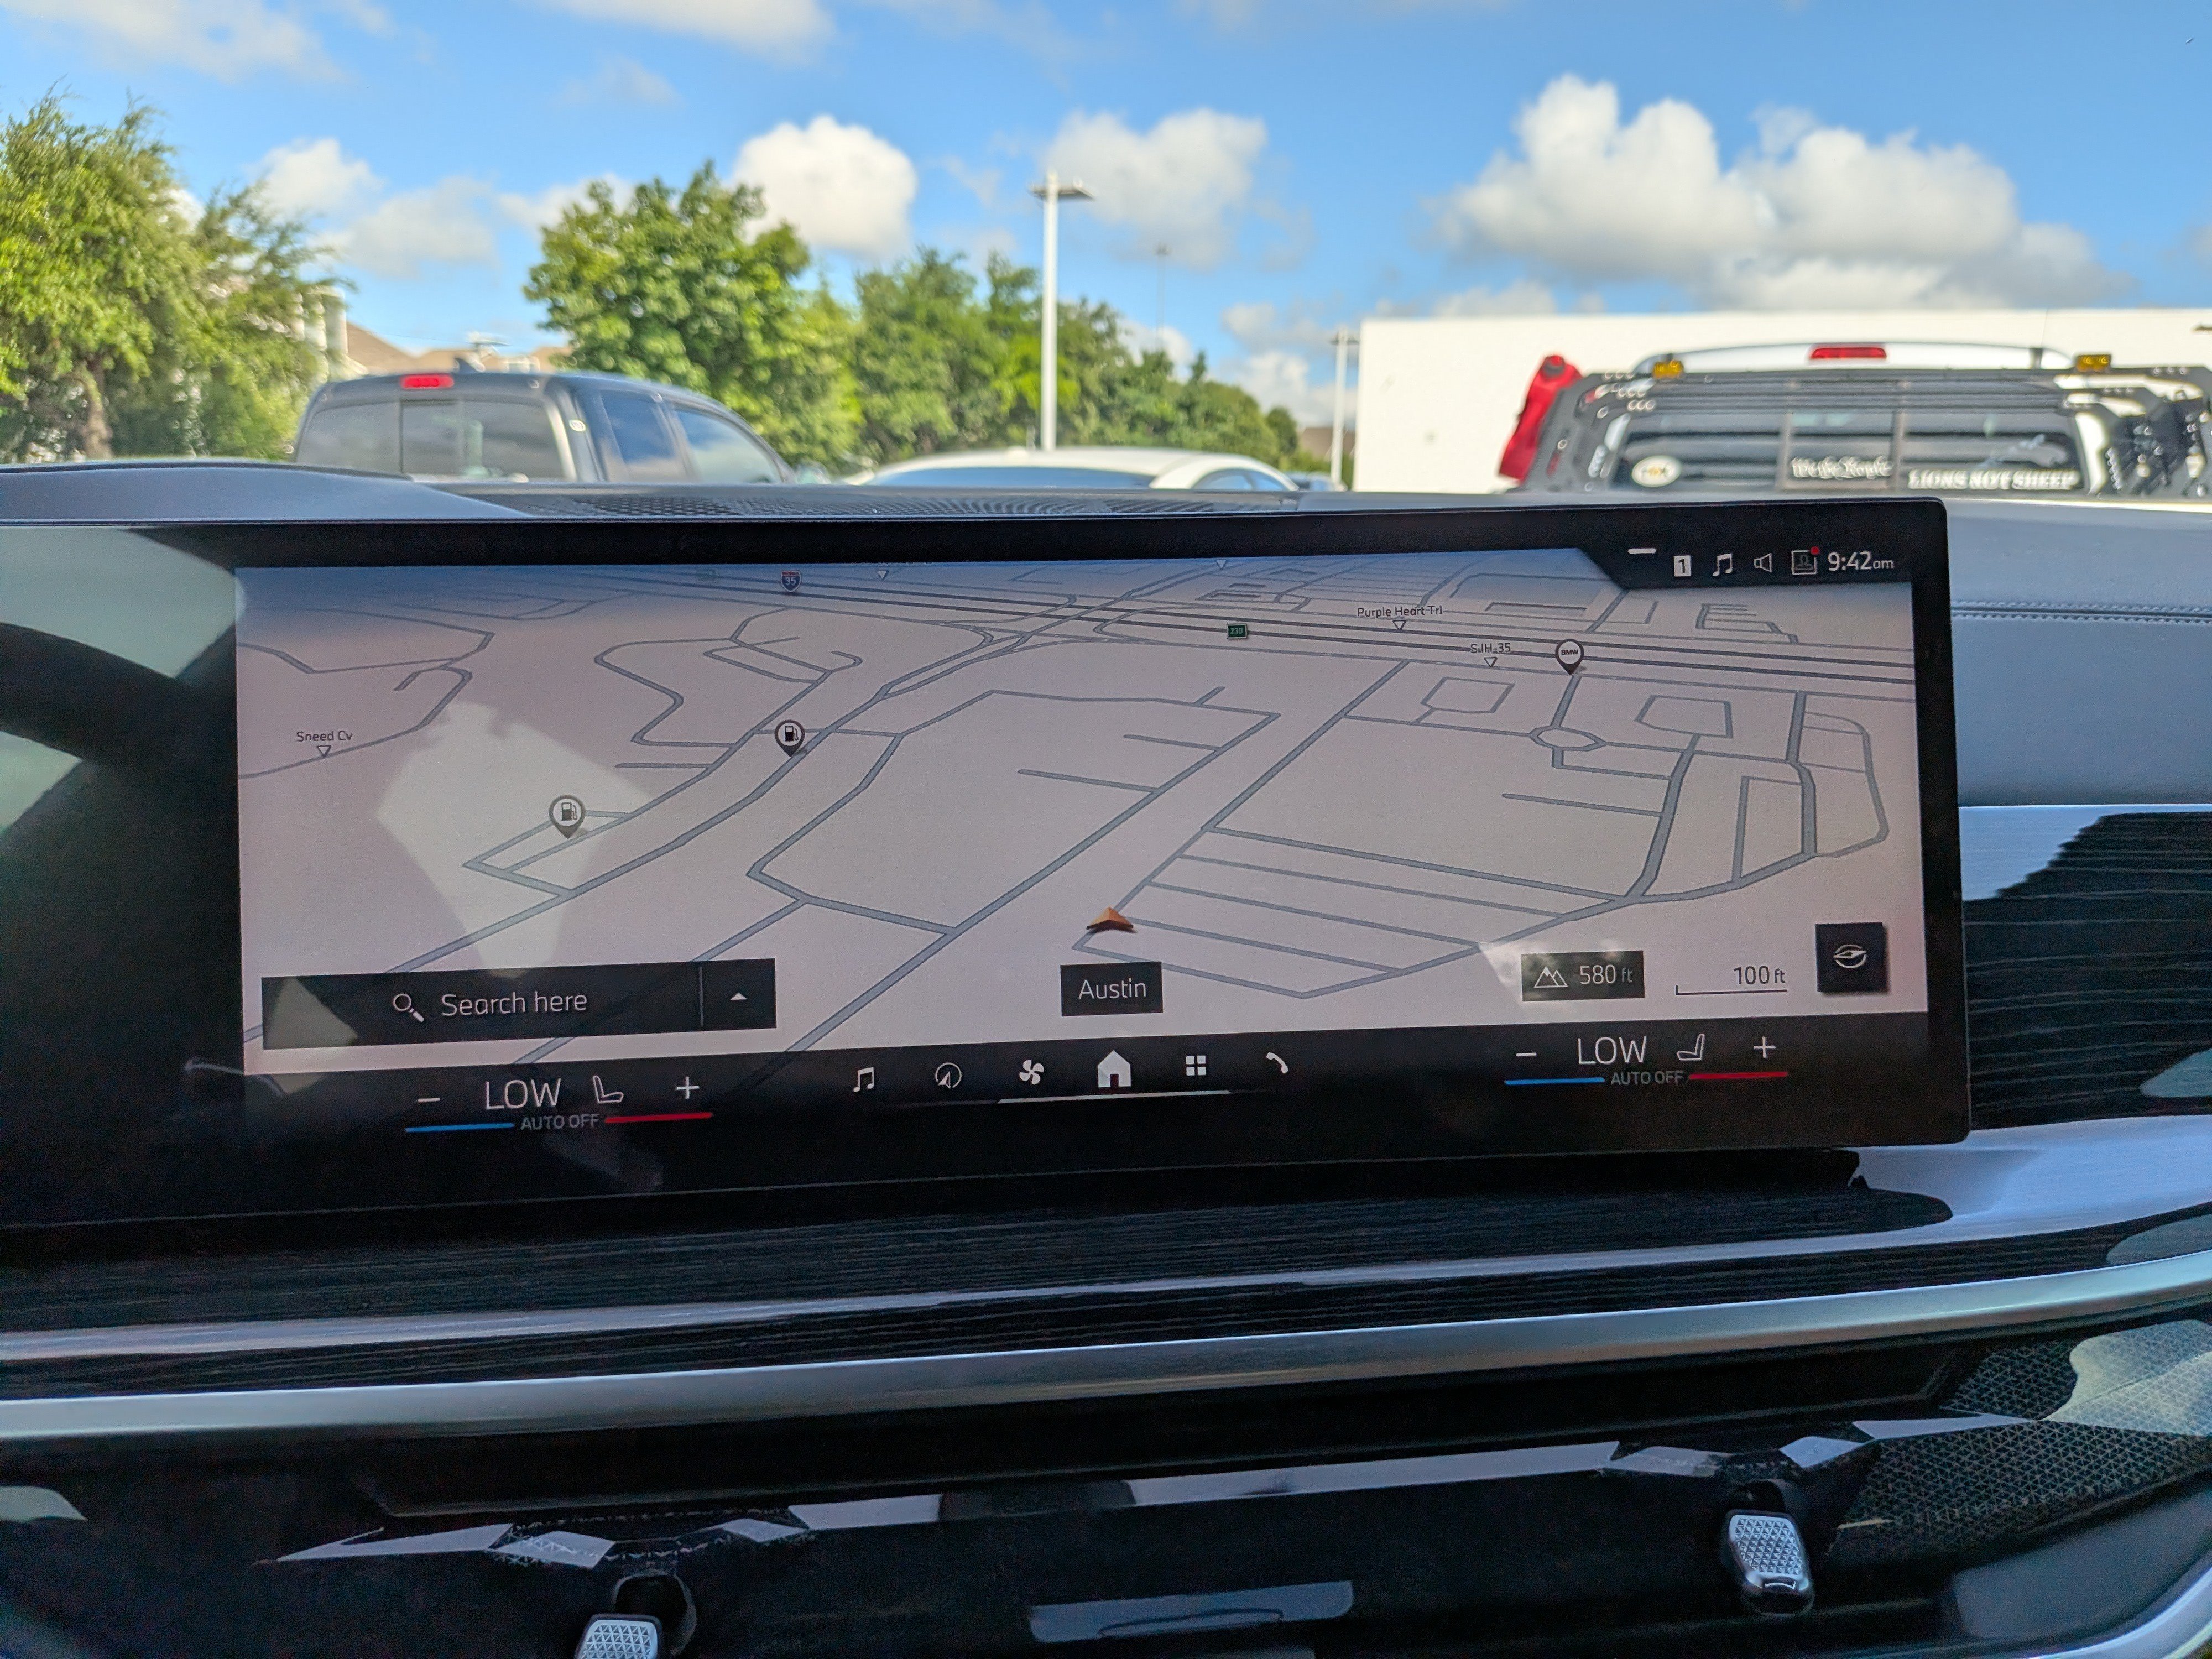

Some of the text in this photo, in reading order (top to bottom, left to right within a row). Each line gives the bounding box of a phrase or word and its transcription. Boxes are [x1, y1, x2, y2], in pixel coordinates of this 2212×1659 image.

[1908, 469, 1967, 490] LIONS
[1969, 469, 2012, 490] NOT
[1677, 558, 1686, 574] 1
[785, 576, 797, 586] 35
[1357, 605, 1443, 618] Purple Heart Trl
[1230, 627, 1244, 635] 230
[296, 730, 353, 742] Sneed Cv
[1579, 964, 1634, 985] 580 ft
[1733, 965, 1786, 985] 100 ft
[1078, 977, 1147, 1000] Austin
[442, 991, 587, 1016] Search here
[1578, 1036, 1647, 1065] LOW
[1610, 1070, 1684, 1086] AUTO OFF
[485, 1078, 561, 1109] LOW
[520, 1113, 601, 1131] AUTO OFF
